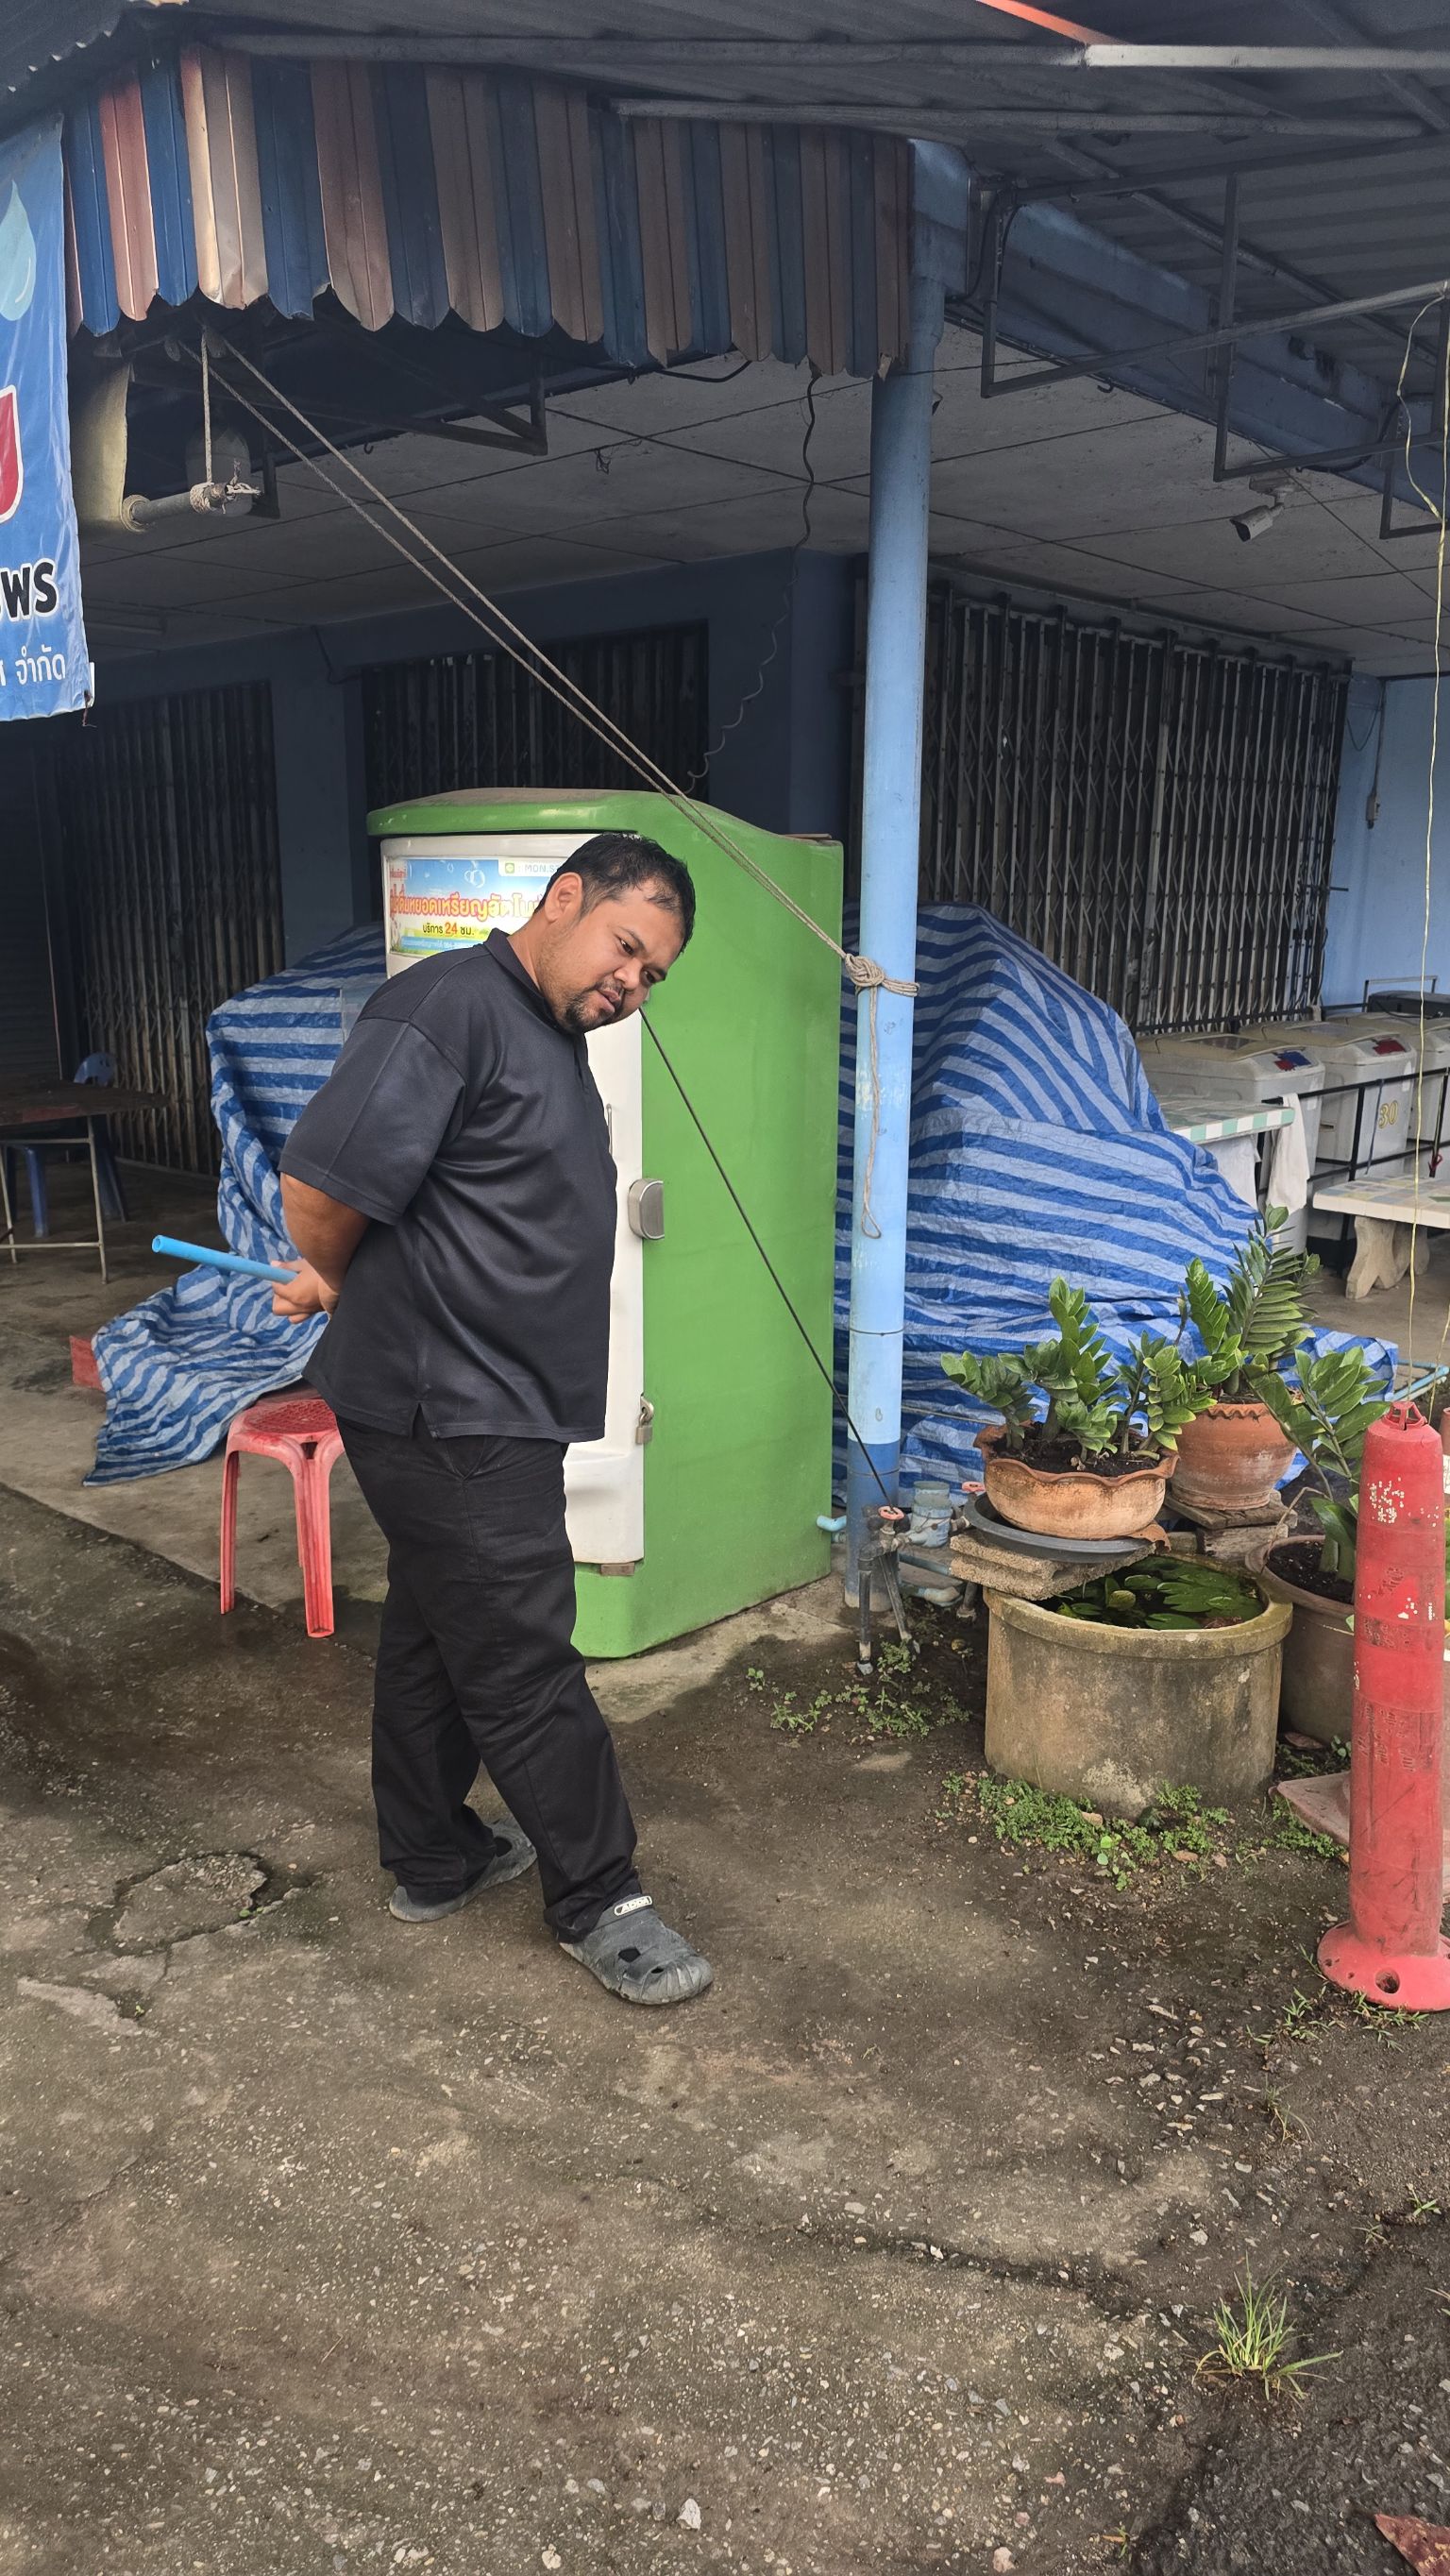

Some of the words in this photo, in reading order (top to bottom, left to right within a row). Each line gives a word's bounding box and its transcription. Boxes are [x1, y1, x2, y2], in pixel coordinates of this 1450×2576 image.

[15, 644, 66, 685] จำกัด
[422, 923, 444, 934] บริการ
[445, 922, 458, 935] 24
[1378, 1100, 1398, 1129] 30
